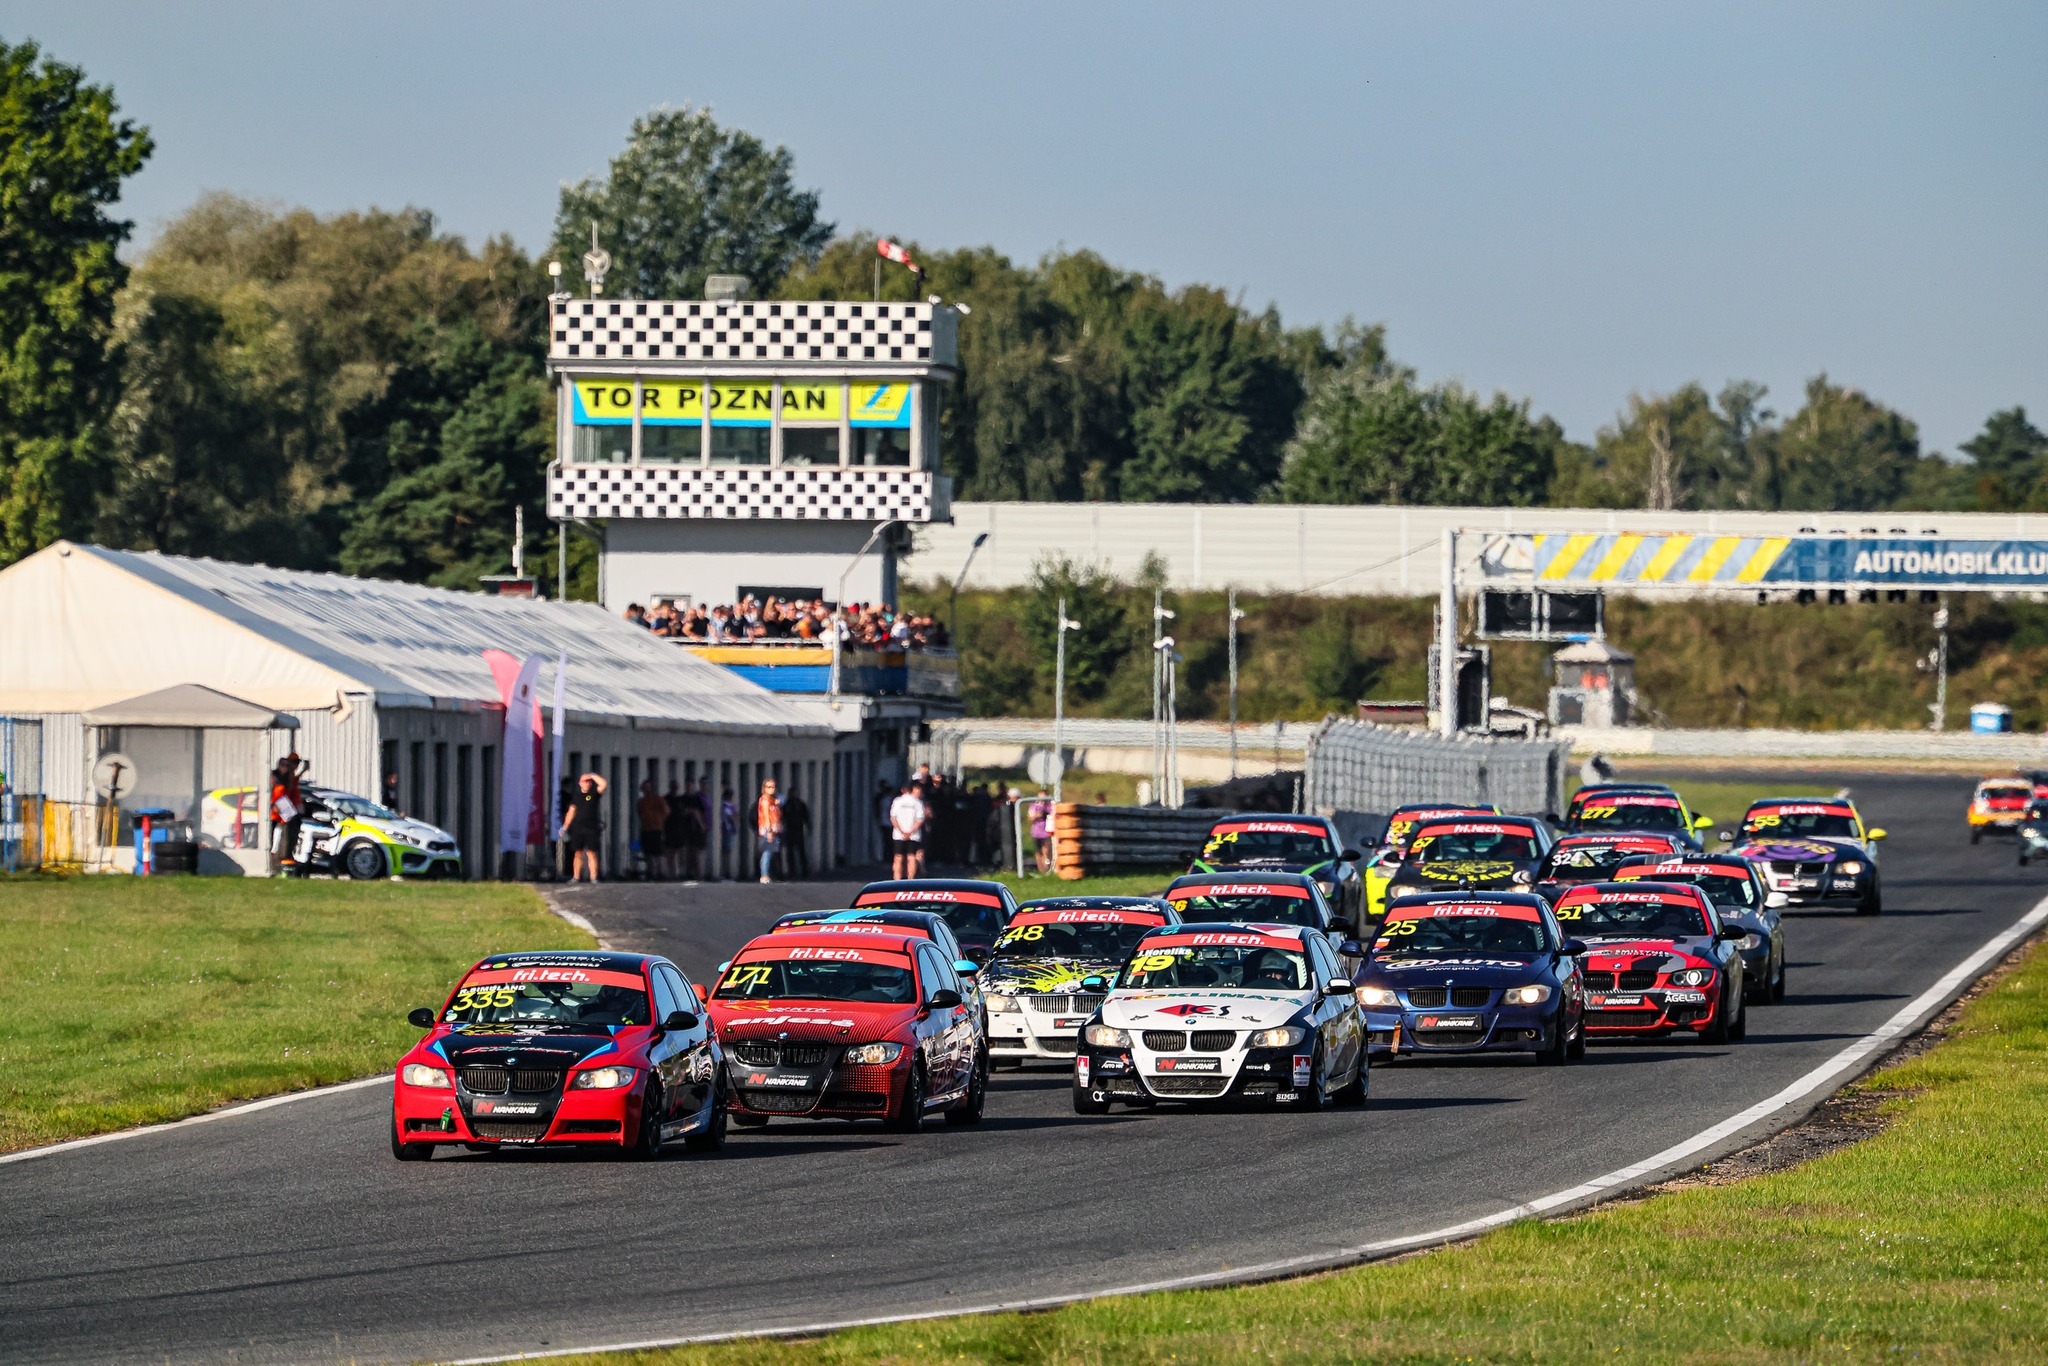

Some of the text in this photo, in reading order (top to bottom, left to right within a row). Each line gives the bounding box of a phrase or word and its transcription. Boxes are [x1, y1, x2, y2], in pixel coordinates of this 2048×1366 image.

[587, 387, 660, 408] TOR
[1853, 551, 2048, 575] AUTOMOBILKLU
[1580, 806, 1617, 820] 277
[1754, 814, 1782, 827] 55
[1213, 831, 1239, 845] 14
[1411, 836, 1436, 849] 67
[1655, 865, 1714, 874] fri.tech.
[894, 891, 958, 901] fri.tech.
[1210, 884, 1272, 895] fri.tech.
[1600, 892, 1664, 902] fri.tech.
[1057, 911, 1124, 922] fri.tech.
[1433, 906, 1500, 917] fri.tech.
[1556, 905, 1583, 921] 51
[1004, 925, 1045, 942] 48
[1381, 919, 1419, 937] 25
[1192, 933, 1265, 945] fri.tech.
[788, 947, 864, 961] fri.tech.
[1130, 954, 1176, 972] 19
[512, 969, 590, 982] fri.tech.
[723, 966, 773, 985] 171
[452, 989, 516, 1012] 335
[1174, 1062, 1217, 1070] NANKANG
[764, 1077, 808, 1087] NANKANG
[492, 1106, 538, 1114] NANKANG
